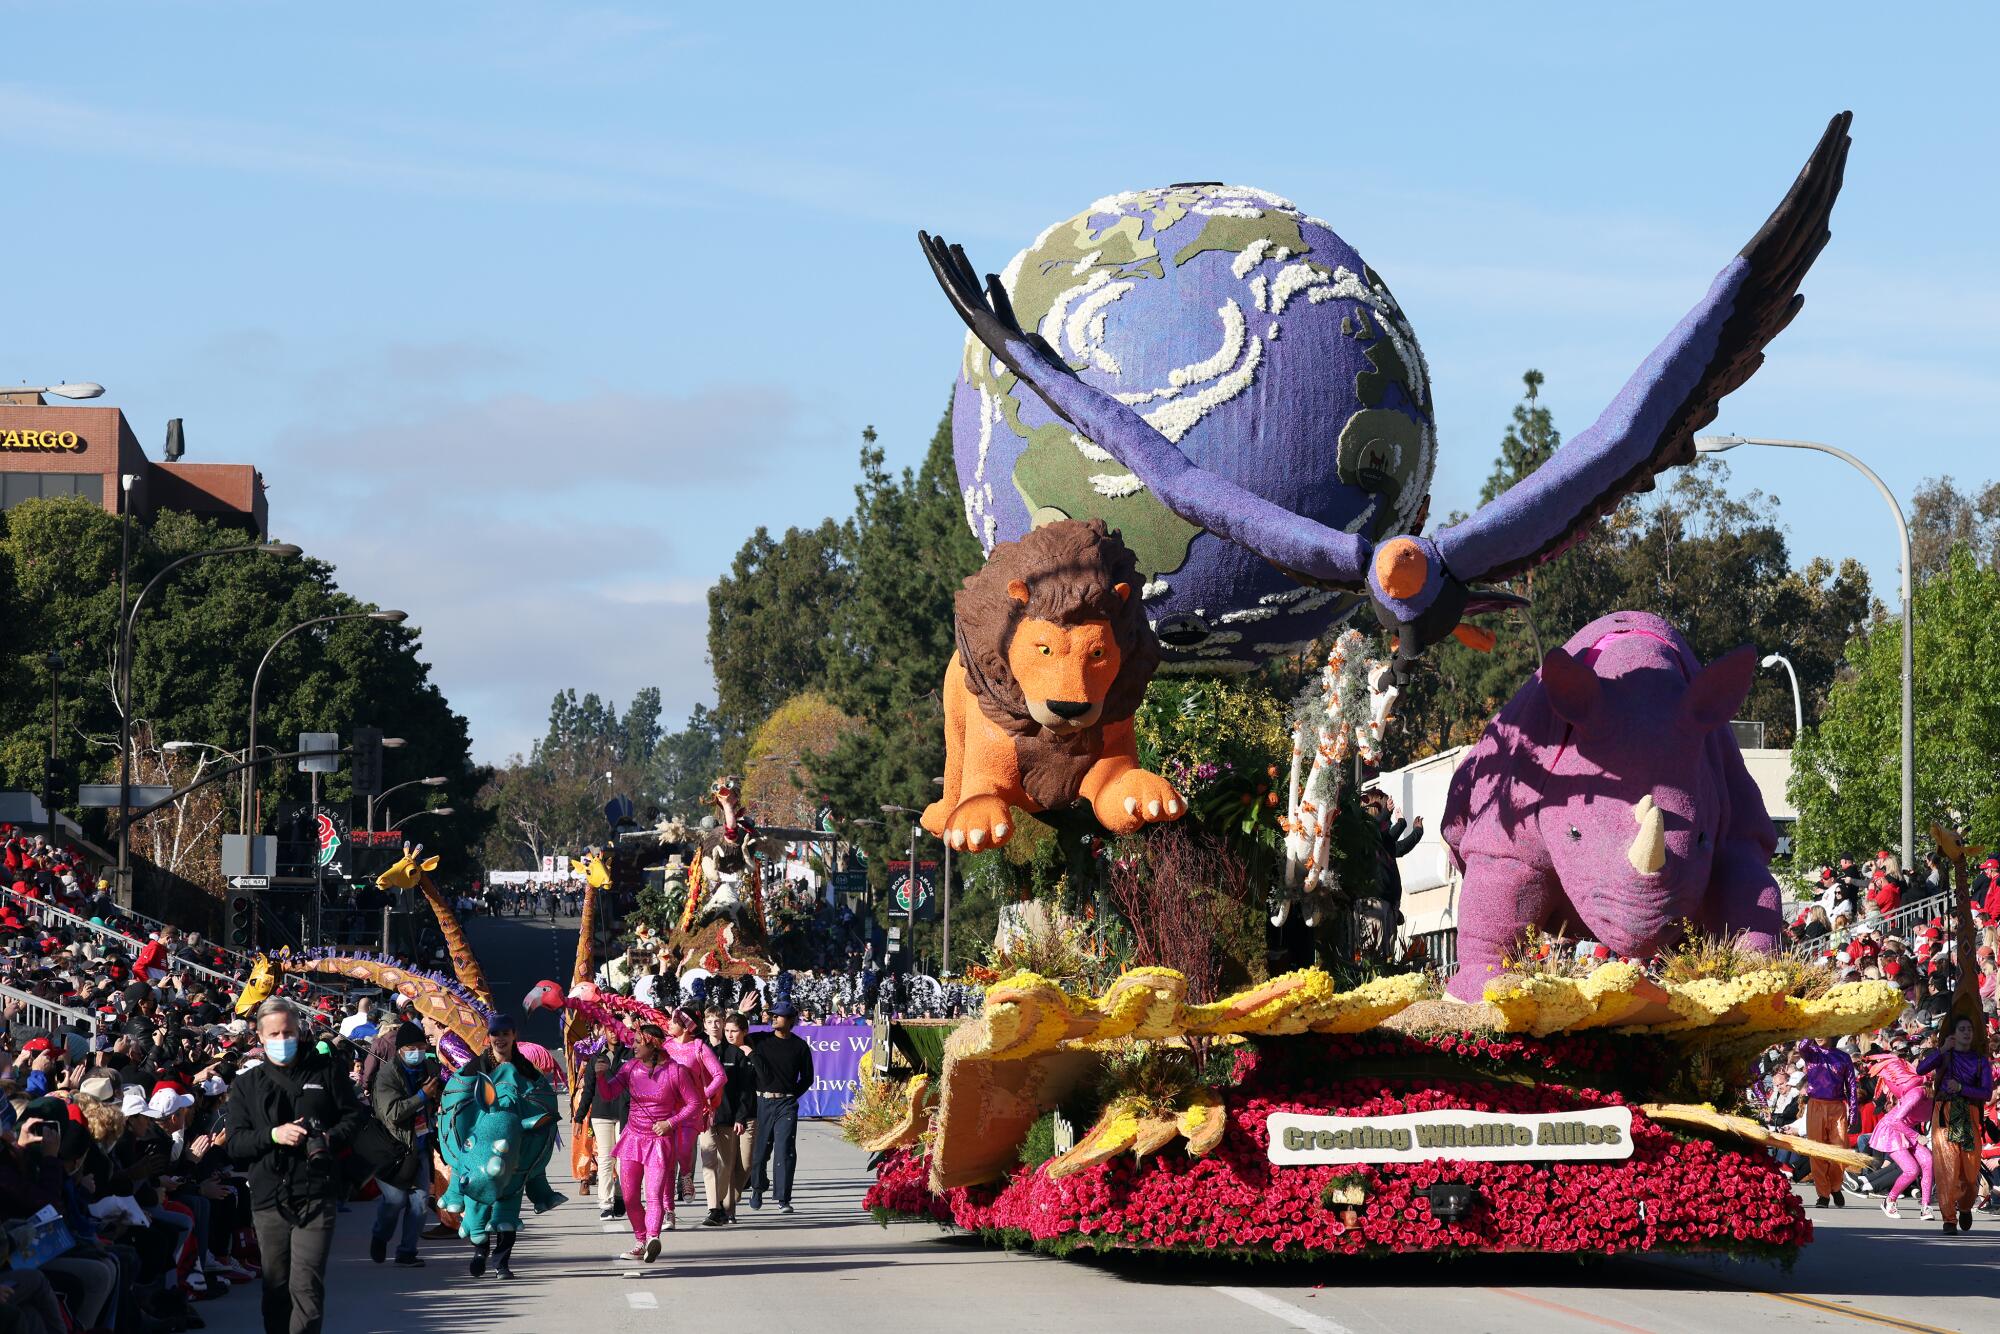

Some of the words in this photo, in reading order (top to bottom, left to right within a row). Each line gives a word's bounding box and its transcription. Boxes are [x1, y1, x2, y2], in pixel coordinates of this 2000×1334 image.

[319, 806, 351, 841] PARADE
[891, 874, 907, 890] ROSE
[916, 873, 934, 897] PARADE
[806, 1036, 840, 1052] kee
[848, 1036, 871, 1052] W
[1283, 1126, 1411, 1151] Creating
[1415, 1123, 1531, 1147] Wildlife
[1537, 1121, 1622, 1145] Allies
